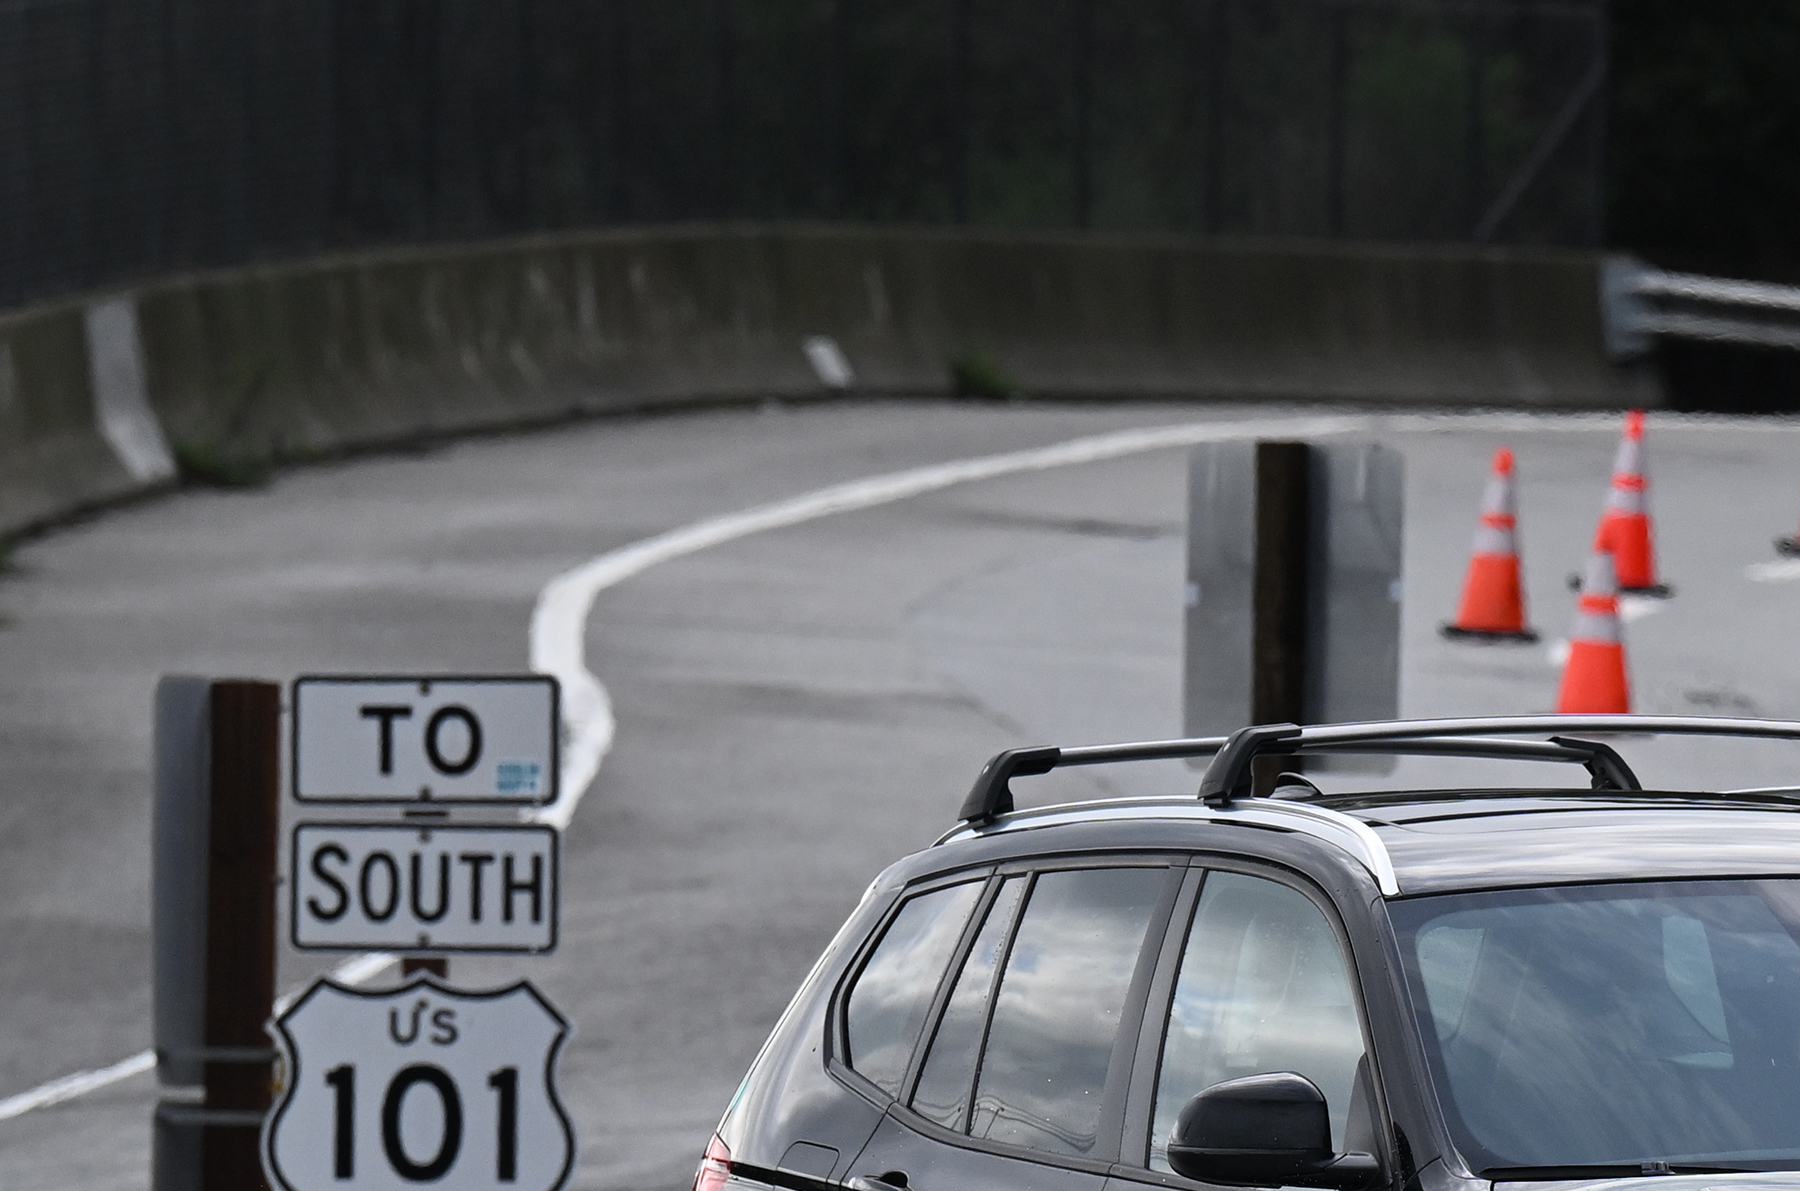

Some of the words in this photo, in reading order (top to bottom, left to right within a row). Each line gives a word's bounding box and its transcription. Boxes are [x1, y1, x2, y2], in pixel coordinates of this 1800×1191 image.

[360, 704, 484, 777] TO
[307, 844, 543, 925] SOUTH
[388, 1006, 459, 1047] US
[325, 1062, 518, 1183] 101
